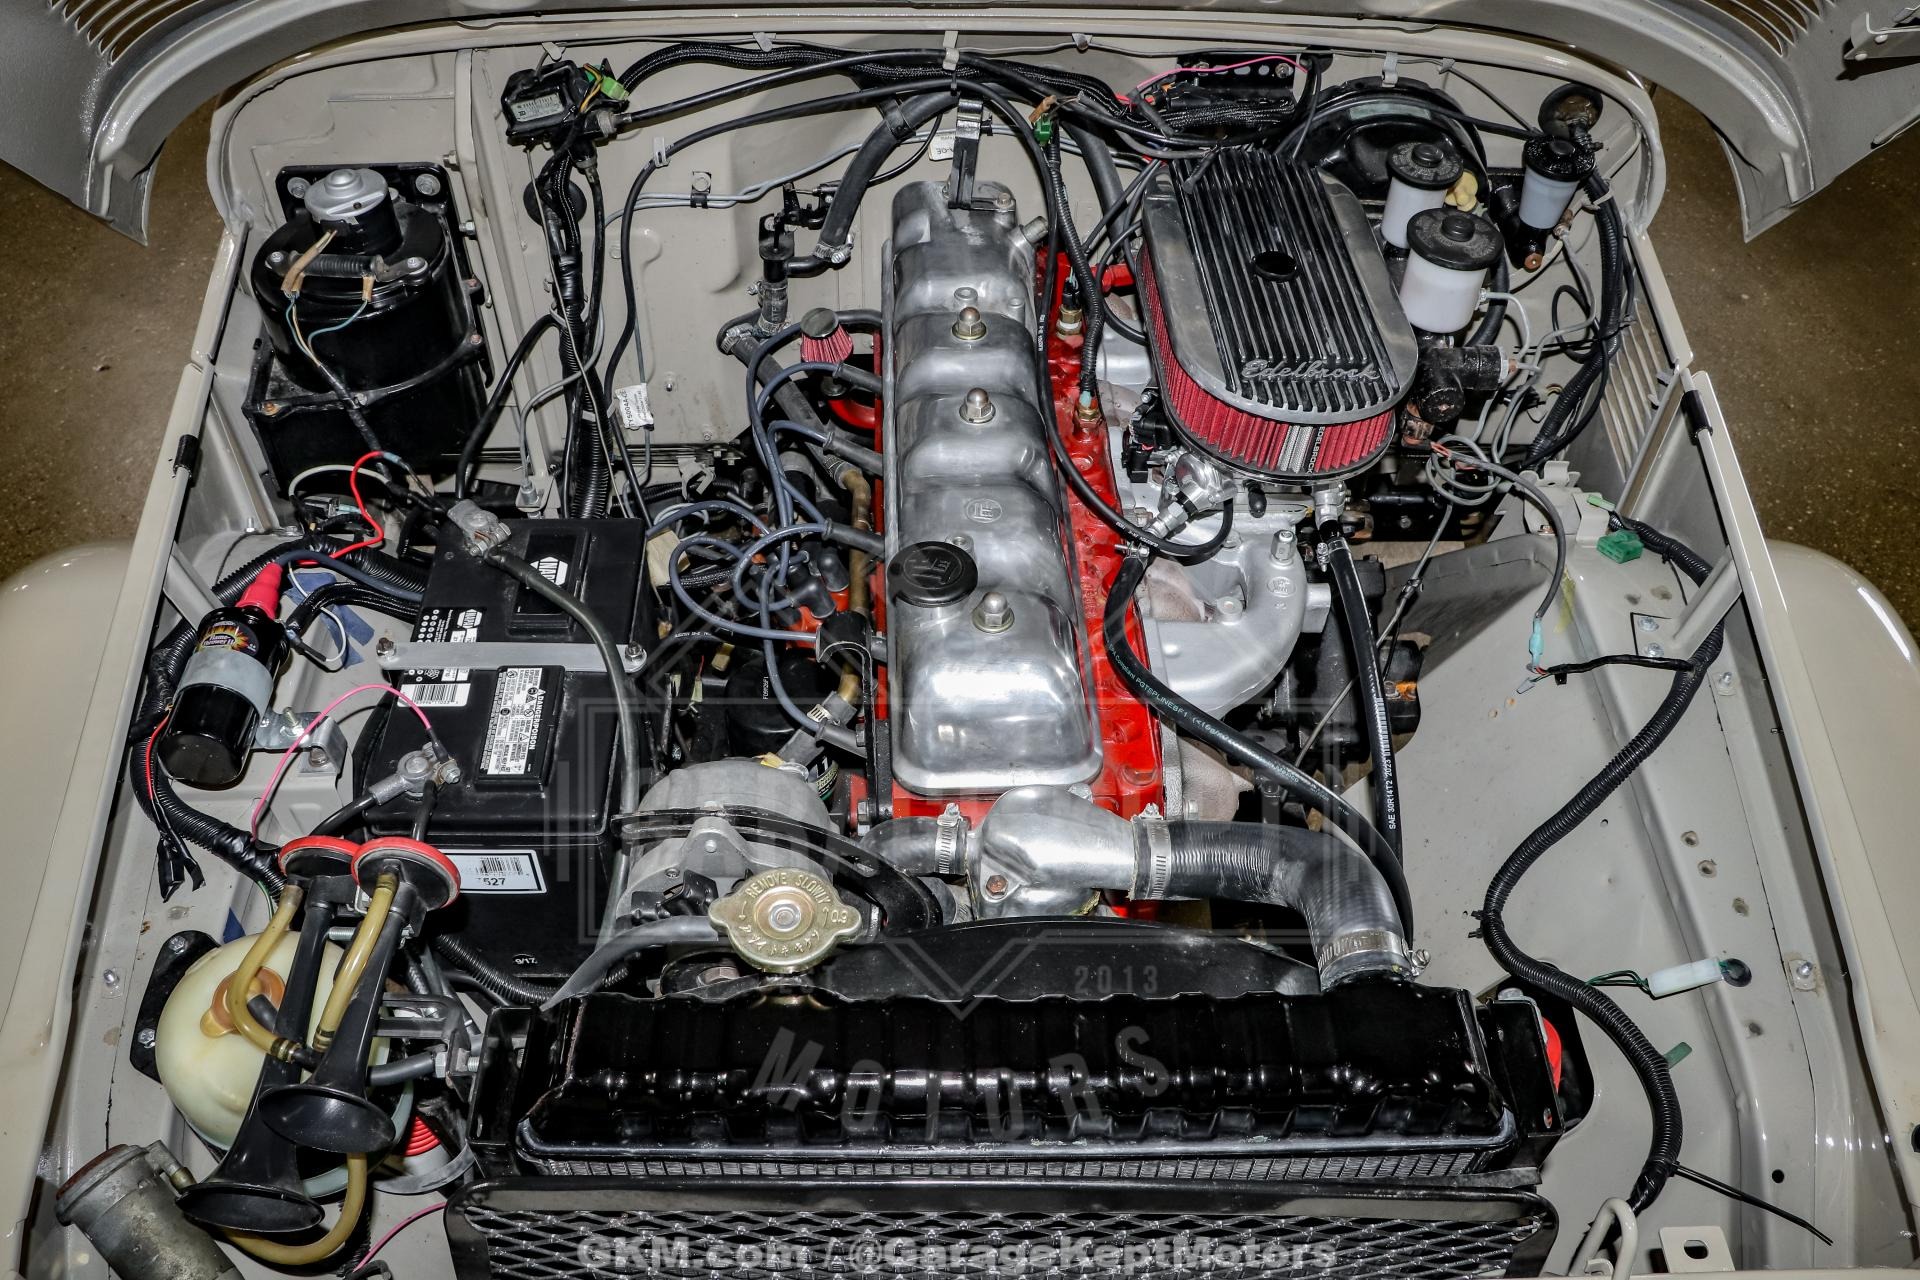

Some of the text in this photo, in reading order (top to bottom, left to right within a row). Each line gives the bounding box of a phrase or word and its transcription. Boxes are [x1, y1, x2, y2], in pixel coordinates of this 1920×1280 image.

[1241, 359, 1381, 380] Edelbrock
[1307, 426, 1325, 474] EDELBROCK
[1387, 813, 1397, 830] SAE
[745, 872, 832, 904] REMOVE SLOWLY
